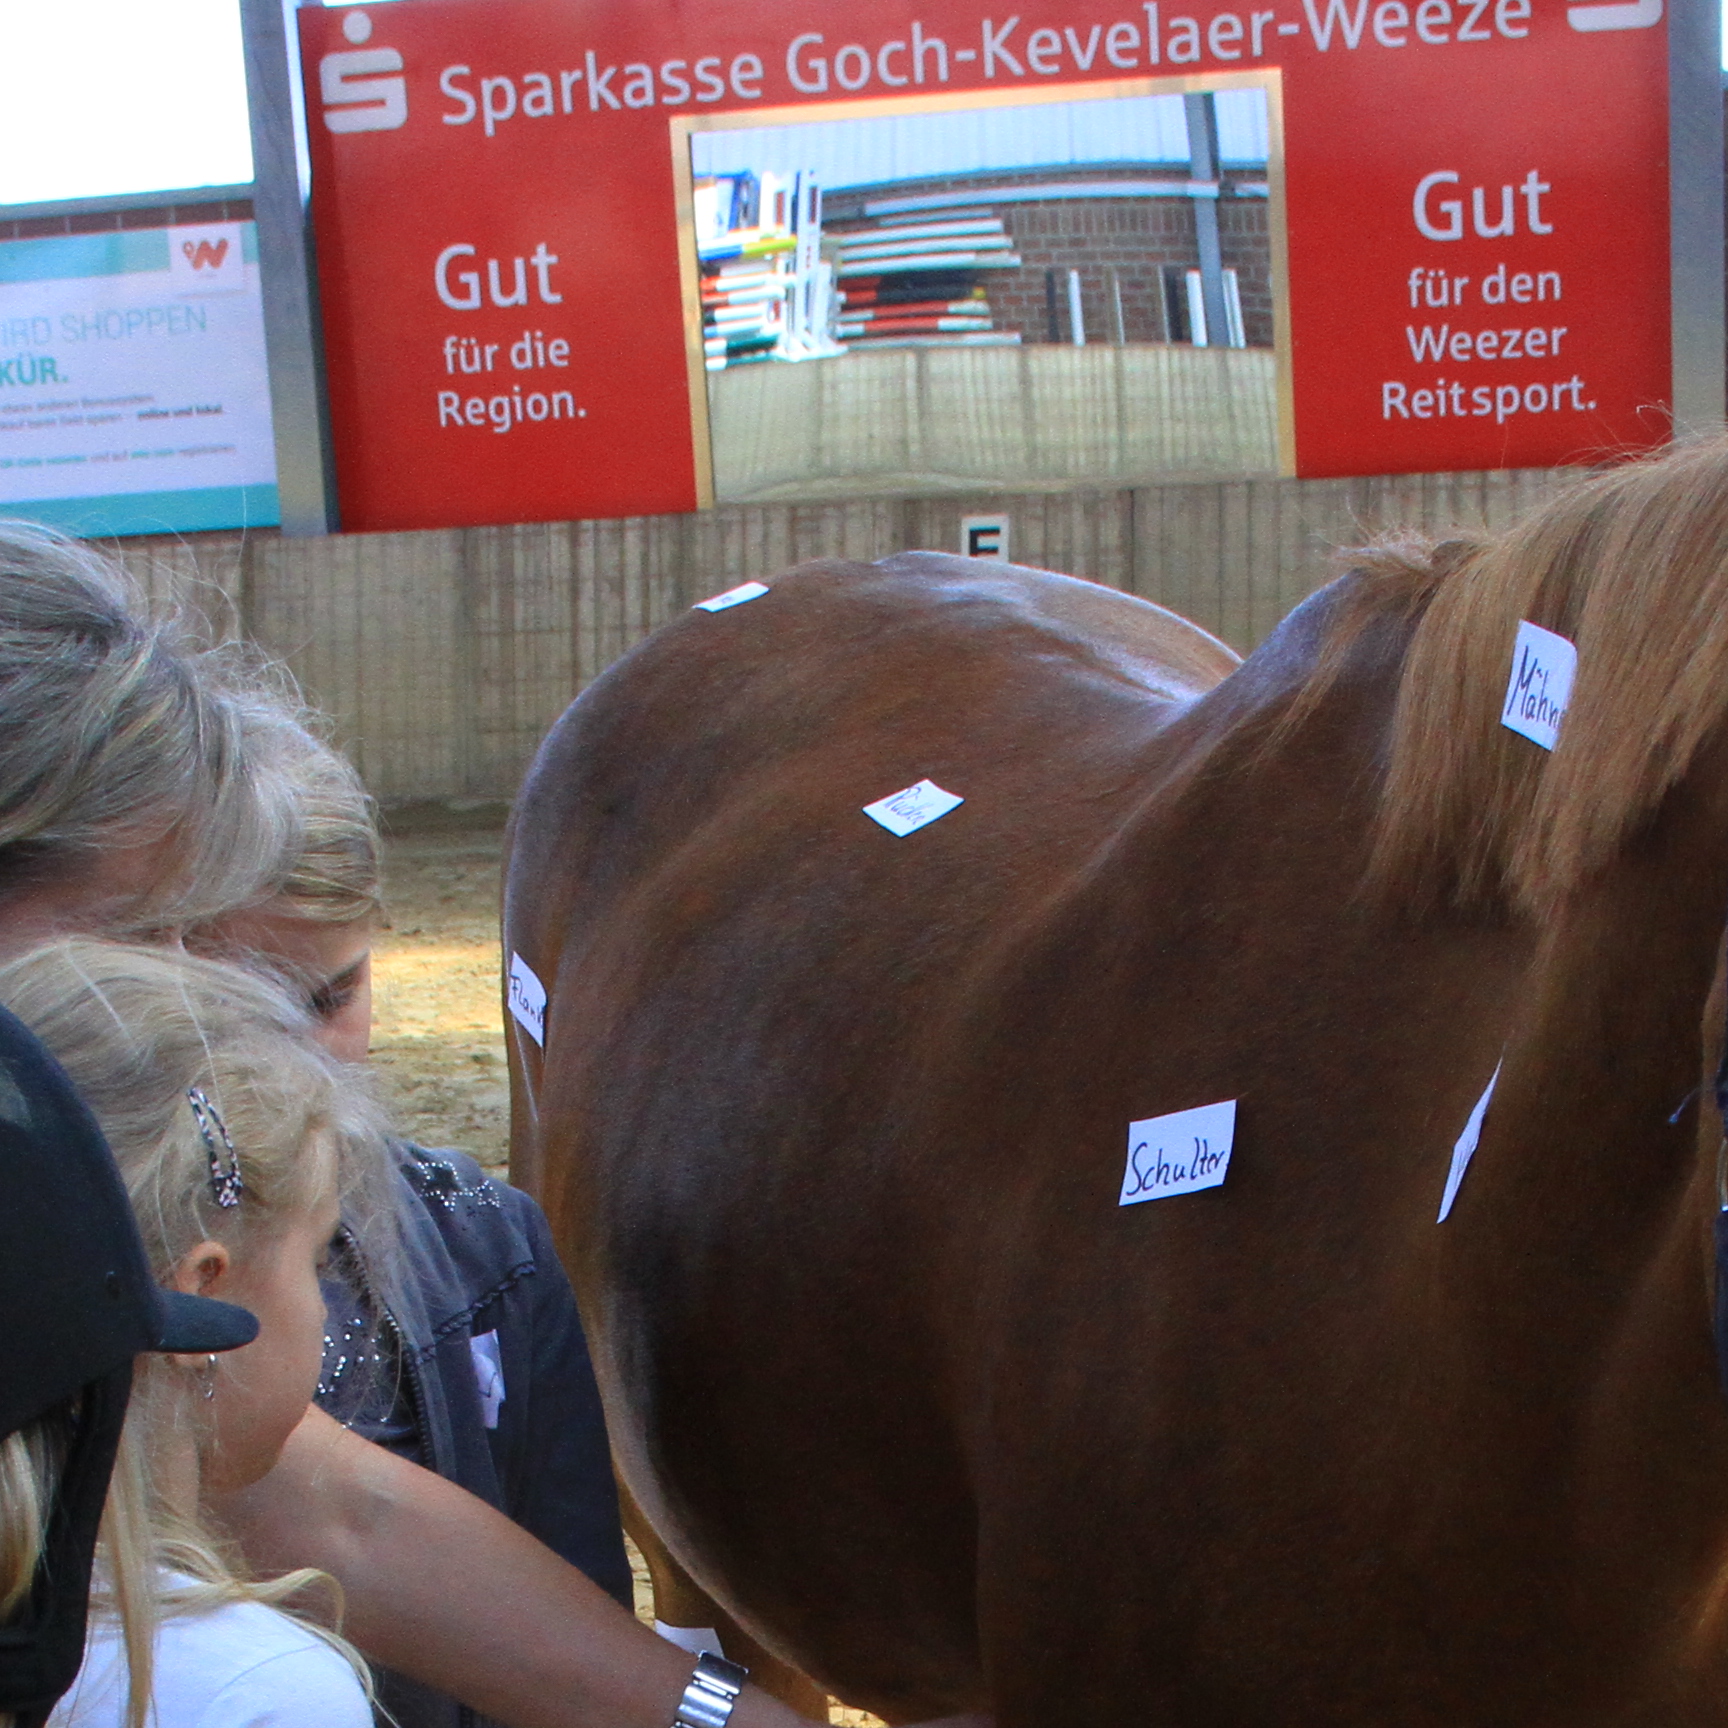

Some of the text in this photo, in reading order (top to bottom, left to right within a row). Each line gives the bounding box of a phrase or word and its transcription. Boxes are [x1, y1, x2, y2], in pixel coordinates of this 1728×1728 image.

[439, 0, 1530, 136] Sparkasse Goch-Kevelaer-Weeze
[1412, 170, 1554, 243] Gut
[433, 242, 564, 311] Gut
[1407, 263, 1562, 309] für den
[59, 303, 208, 344] SHOPPEN
[1406, 321, 1568, 363] Weezer
[444, 330, 571, 375] für die
[437, 386, 587, 433] Region.
[1381, 373, 1597, 426] Reitsport.
[1126, 1136, 1226, 1196] Schulter
